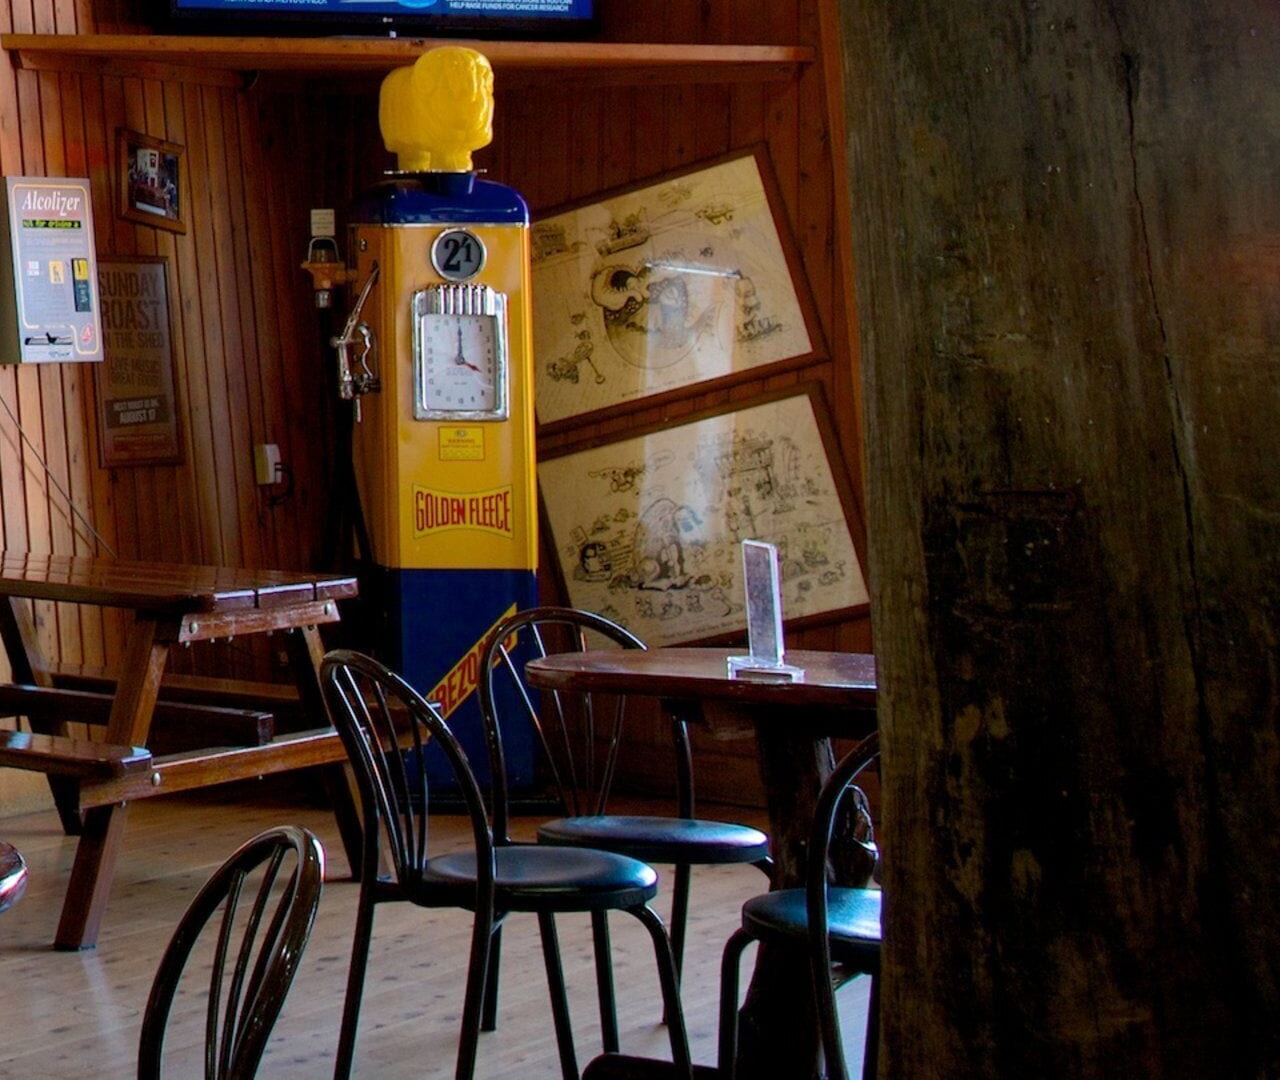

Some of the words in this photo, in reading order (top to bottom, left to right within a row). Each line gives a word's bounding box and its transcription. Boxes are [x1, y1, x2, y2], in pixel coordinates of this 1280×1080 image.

[22, 189, 82, 217] Alcolizer
[416, 491, 466, 532] GOLDEN
[469, 491, 511, 533] FLEECE
